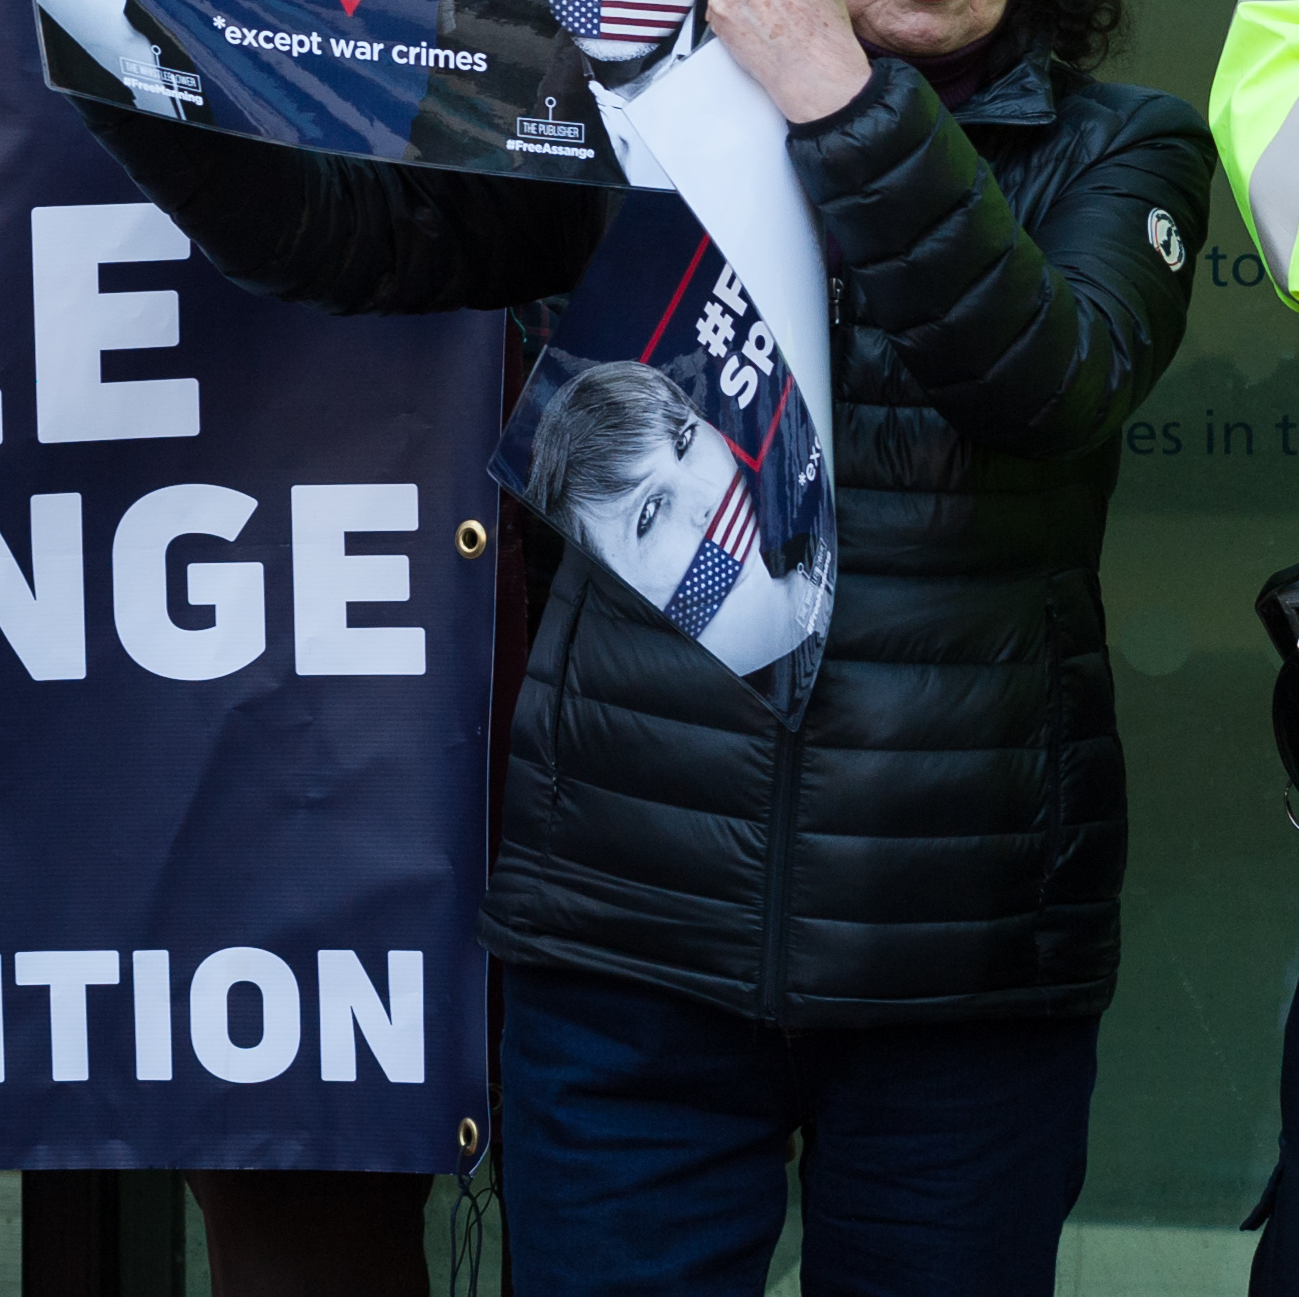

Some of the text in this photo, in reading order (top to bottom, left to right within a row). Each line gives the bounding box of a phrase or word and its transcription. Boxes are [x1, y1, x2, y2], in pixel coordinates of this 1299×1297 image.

[330, 38, 385, 61] war
[391, 41, 488, 72] crimes
[523, 122, 580, 138] THE PUBLISHER
[505, 139, 596, 160] #FreeAssange
[1206, 409, 1253, 455] in
